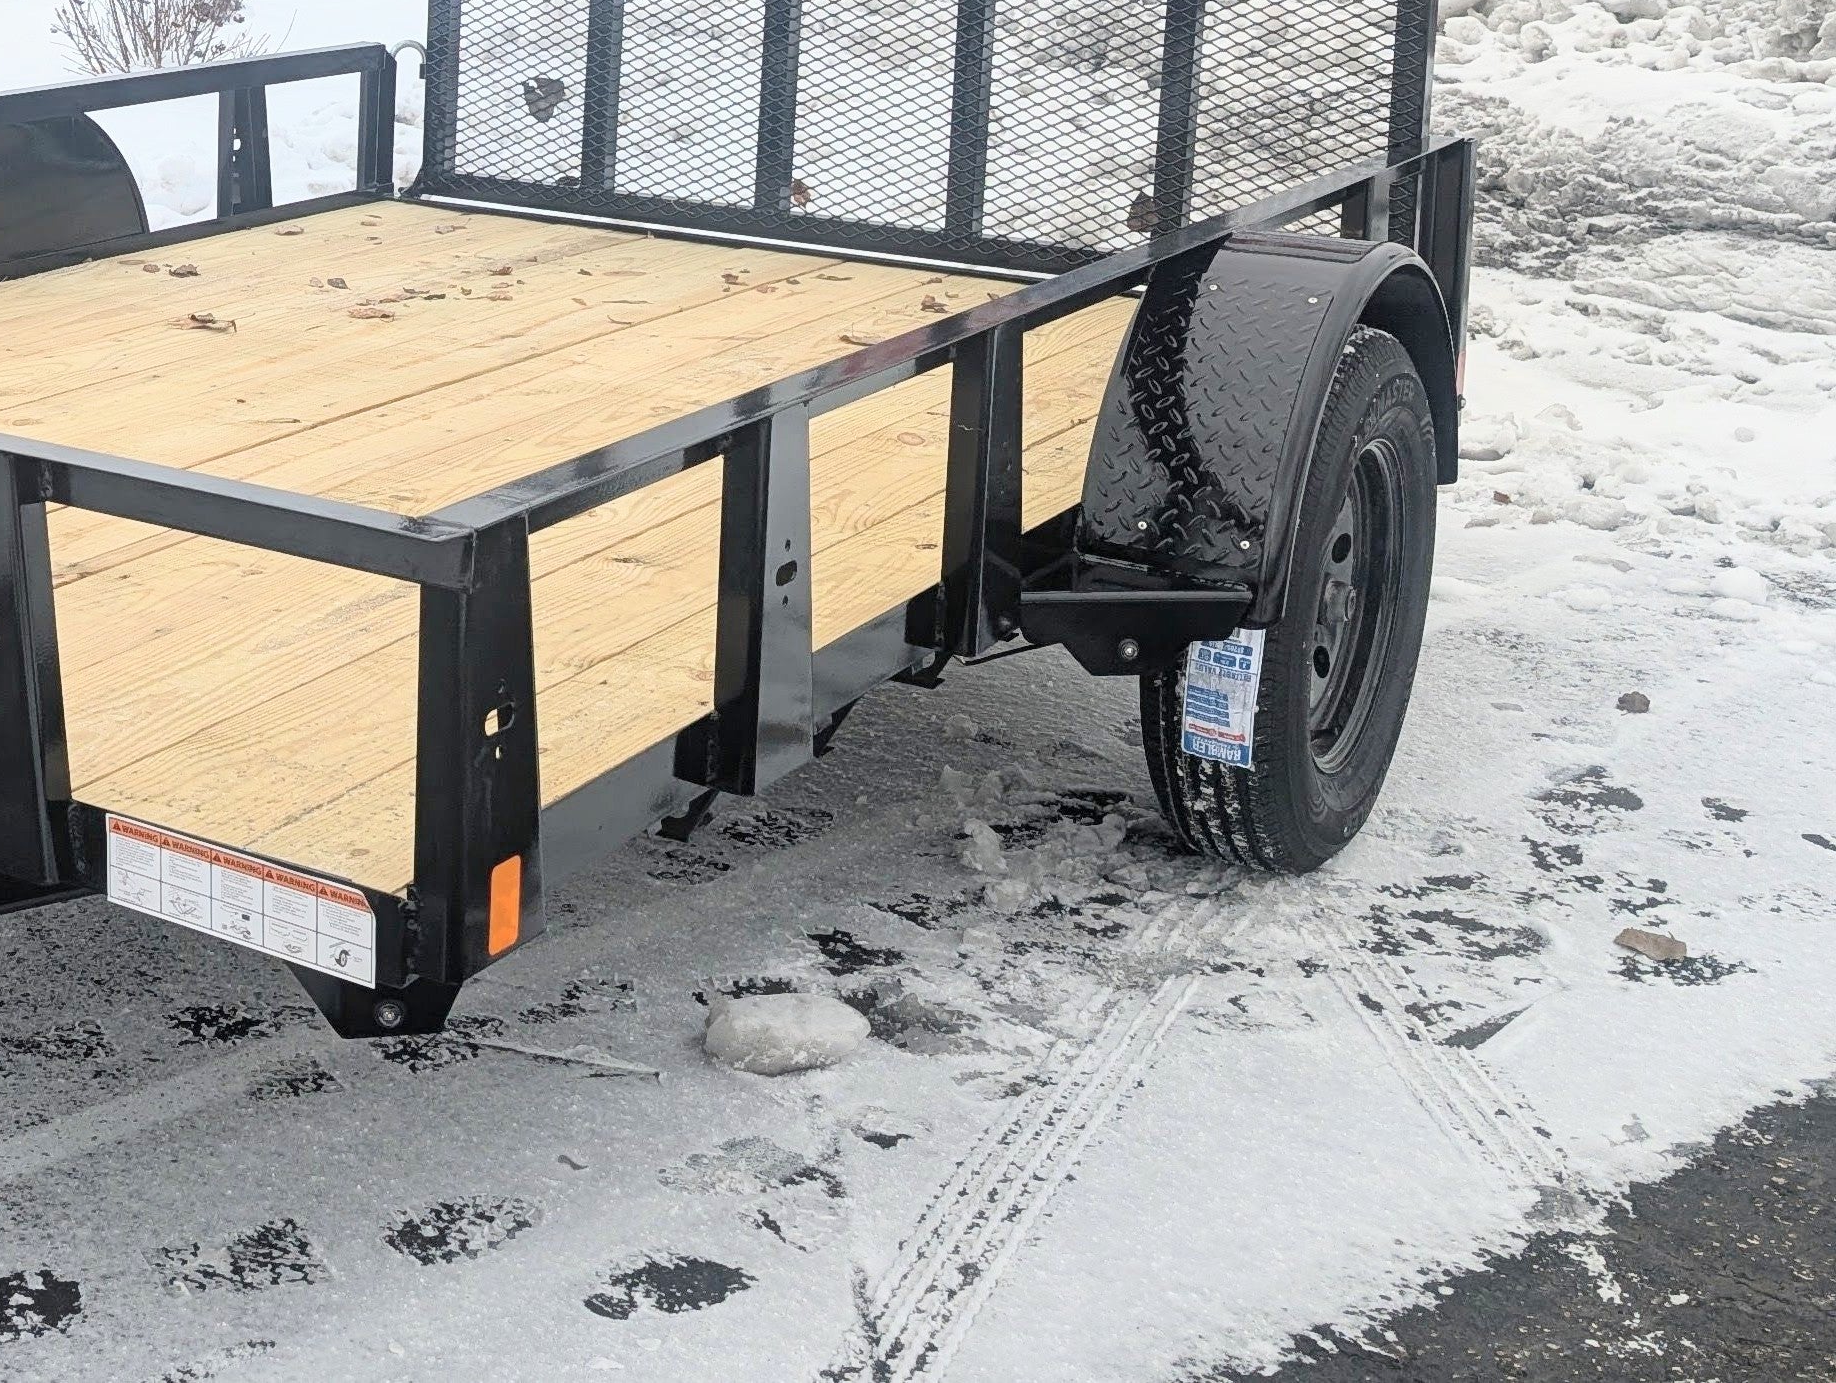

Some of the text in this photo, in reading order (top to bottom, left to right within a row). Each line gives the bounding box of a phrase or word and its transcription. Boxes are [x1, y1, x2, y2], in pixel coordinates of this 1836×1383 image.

[1191, 738, 1242, 761] RAMBLER
[122, 825, 159, 843] WARNING
[172, 841, 209, 859] WARNING
[222, 856, 262, 876] WARNING
[276, 873, 315, 891] WARNING
